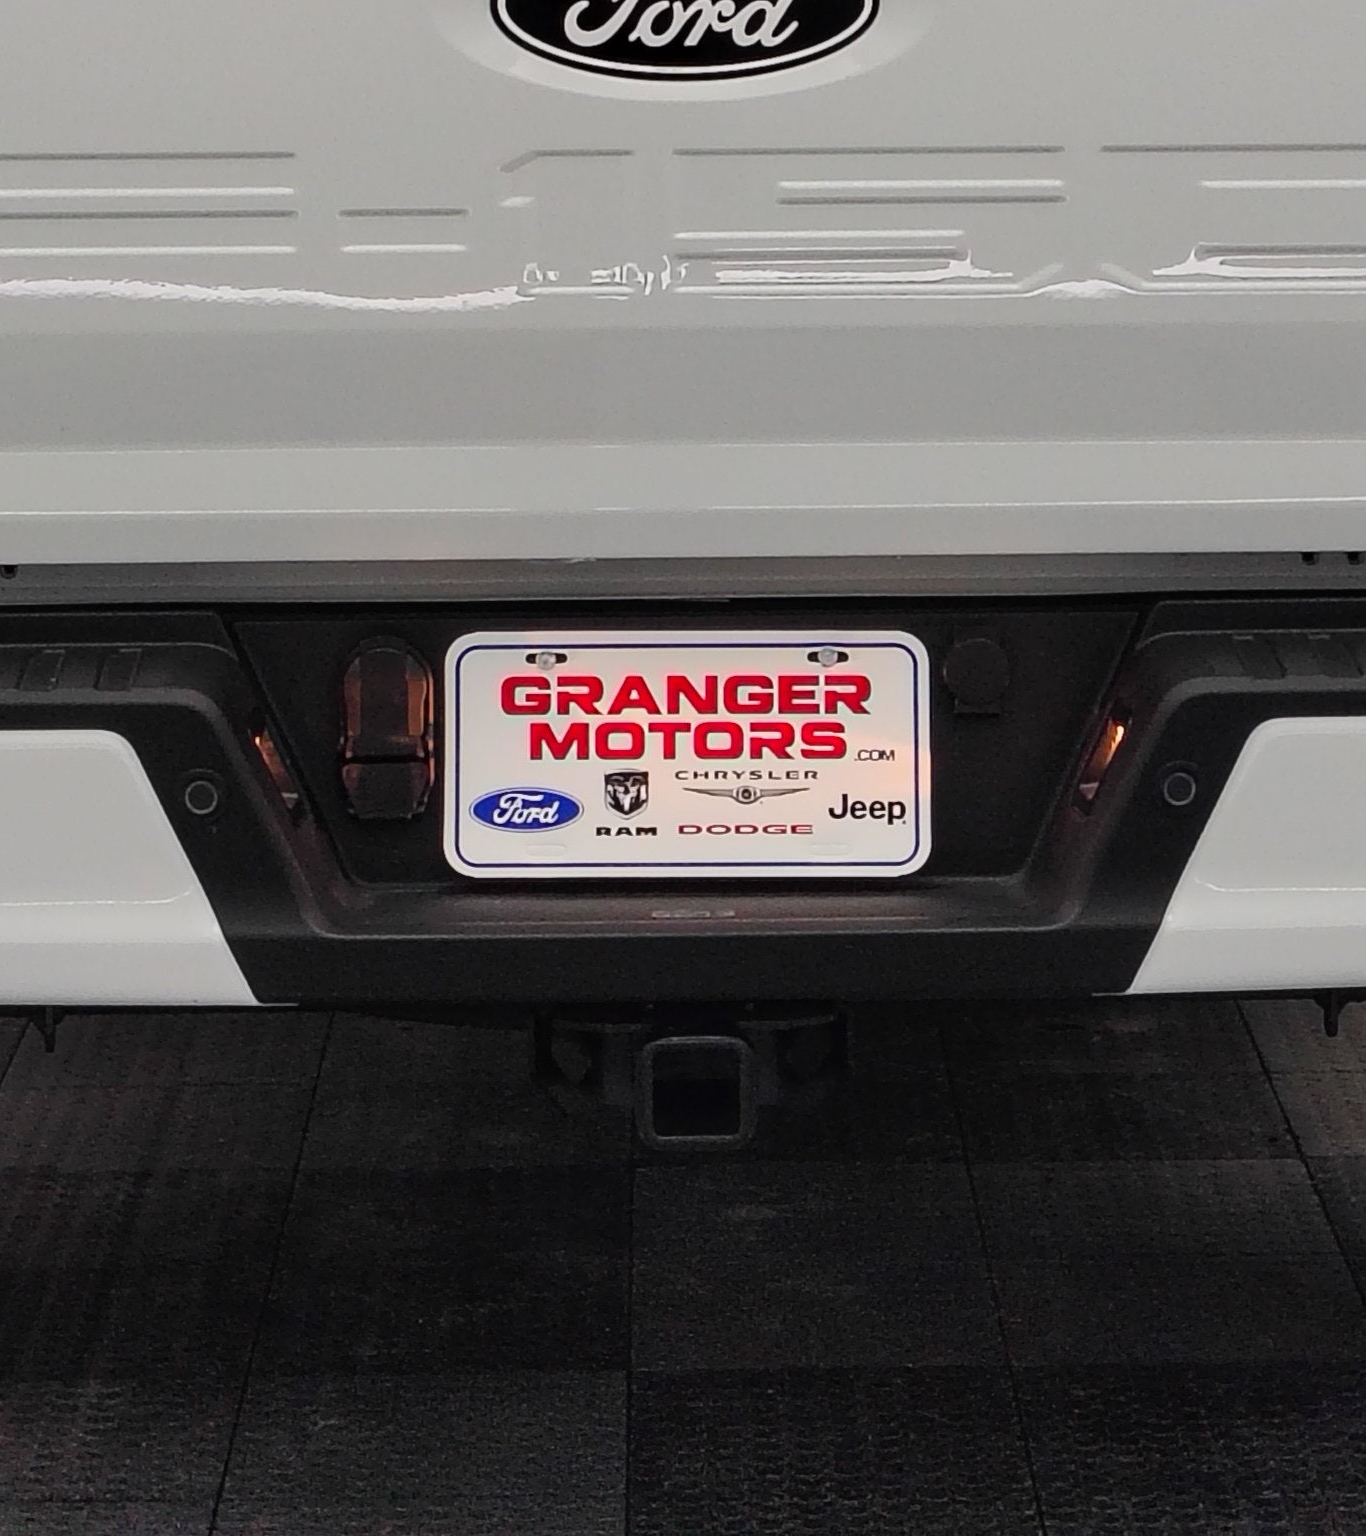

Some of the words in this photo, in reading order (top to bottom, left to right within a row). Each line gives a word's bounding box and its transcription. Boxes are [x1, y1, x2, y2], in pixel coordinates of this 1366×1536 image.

[500, 675, 872, 716] GRANGER
[529, 722, 847, 761] MOTORS
[674, 770, 820, 781] CHRYSLER
[492, 794, 559, 826] Ford
[828, 794, 907, 825] Jeep
[595, 827, 658, 837] RAM
[678, 824, 814, 835] DODGE
